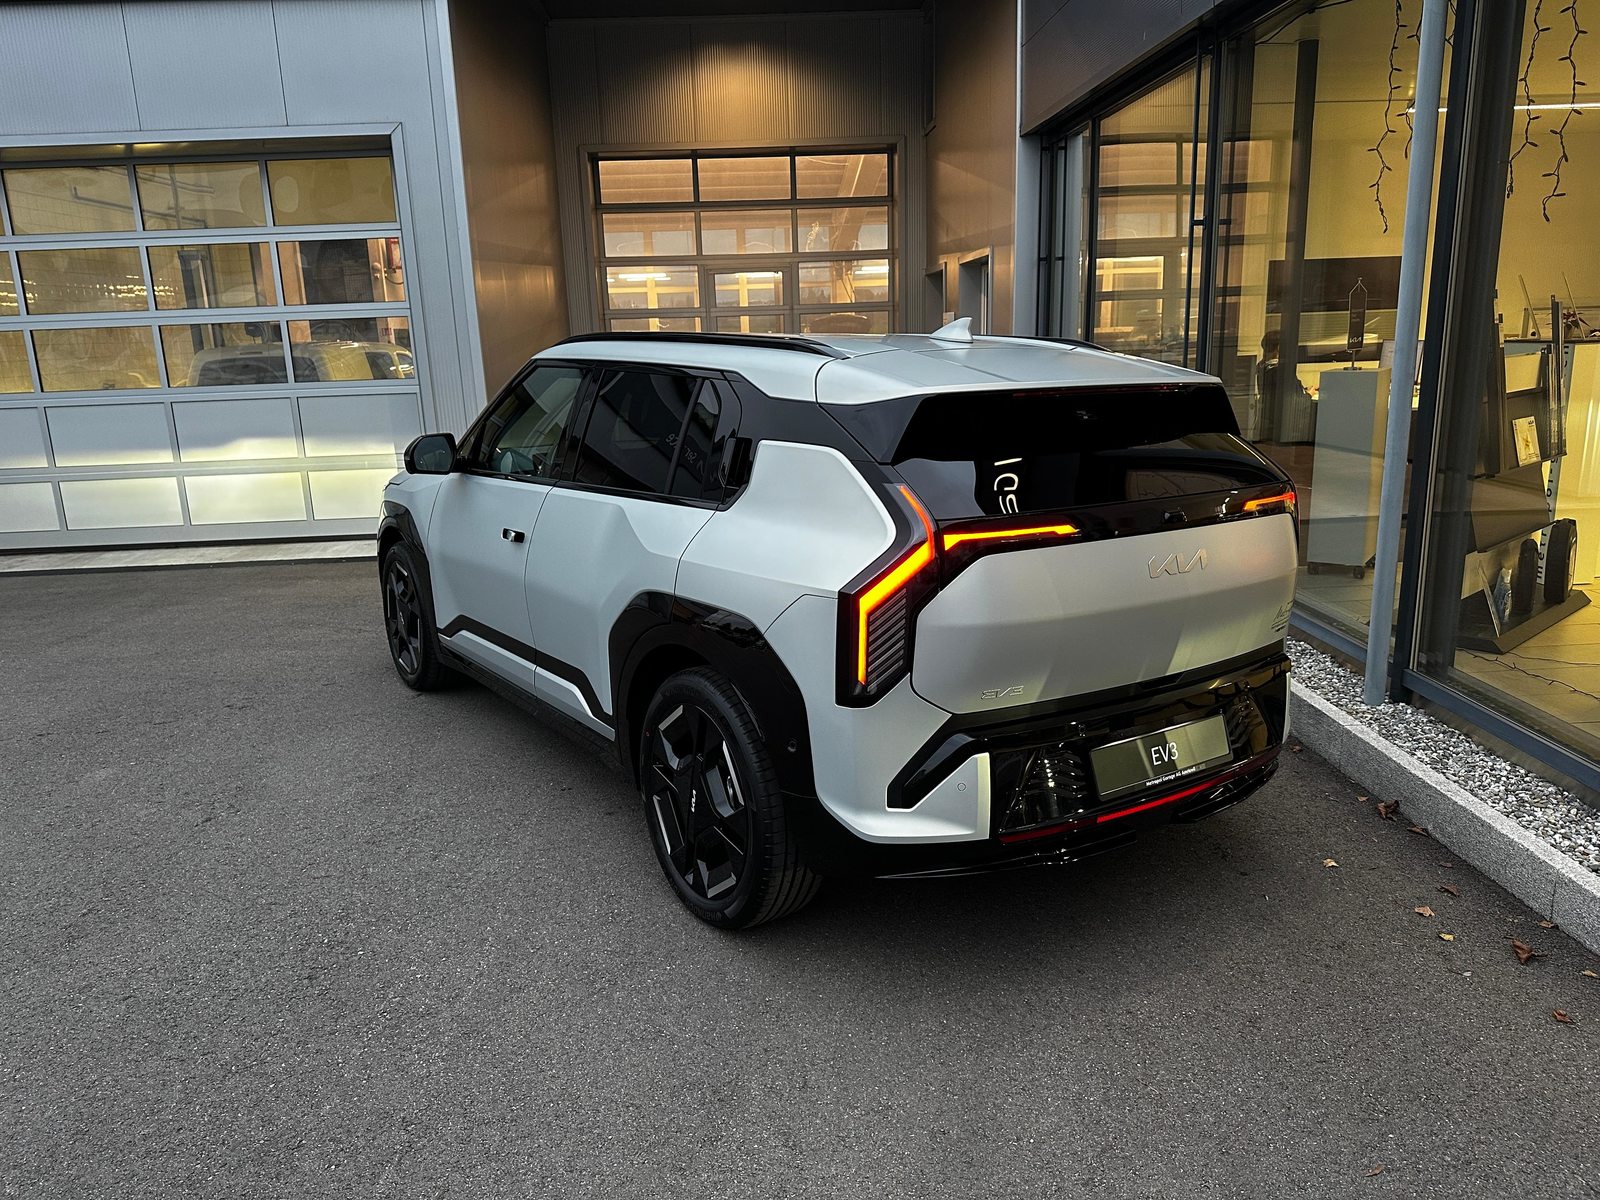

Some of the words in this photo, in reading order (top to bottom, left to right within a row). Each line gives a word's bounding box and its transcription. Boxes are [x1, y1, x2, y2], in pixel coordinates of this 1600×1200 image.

[1148, 548, 1208, 579] KIA
[981, 685, 1024, 699] EV3
[1151, 742, 1179, 765] EV3
